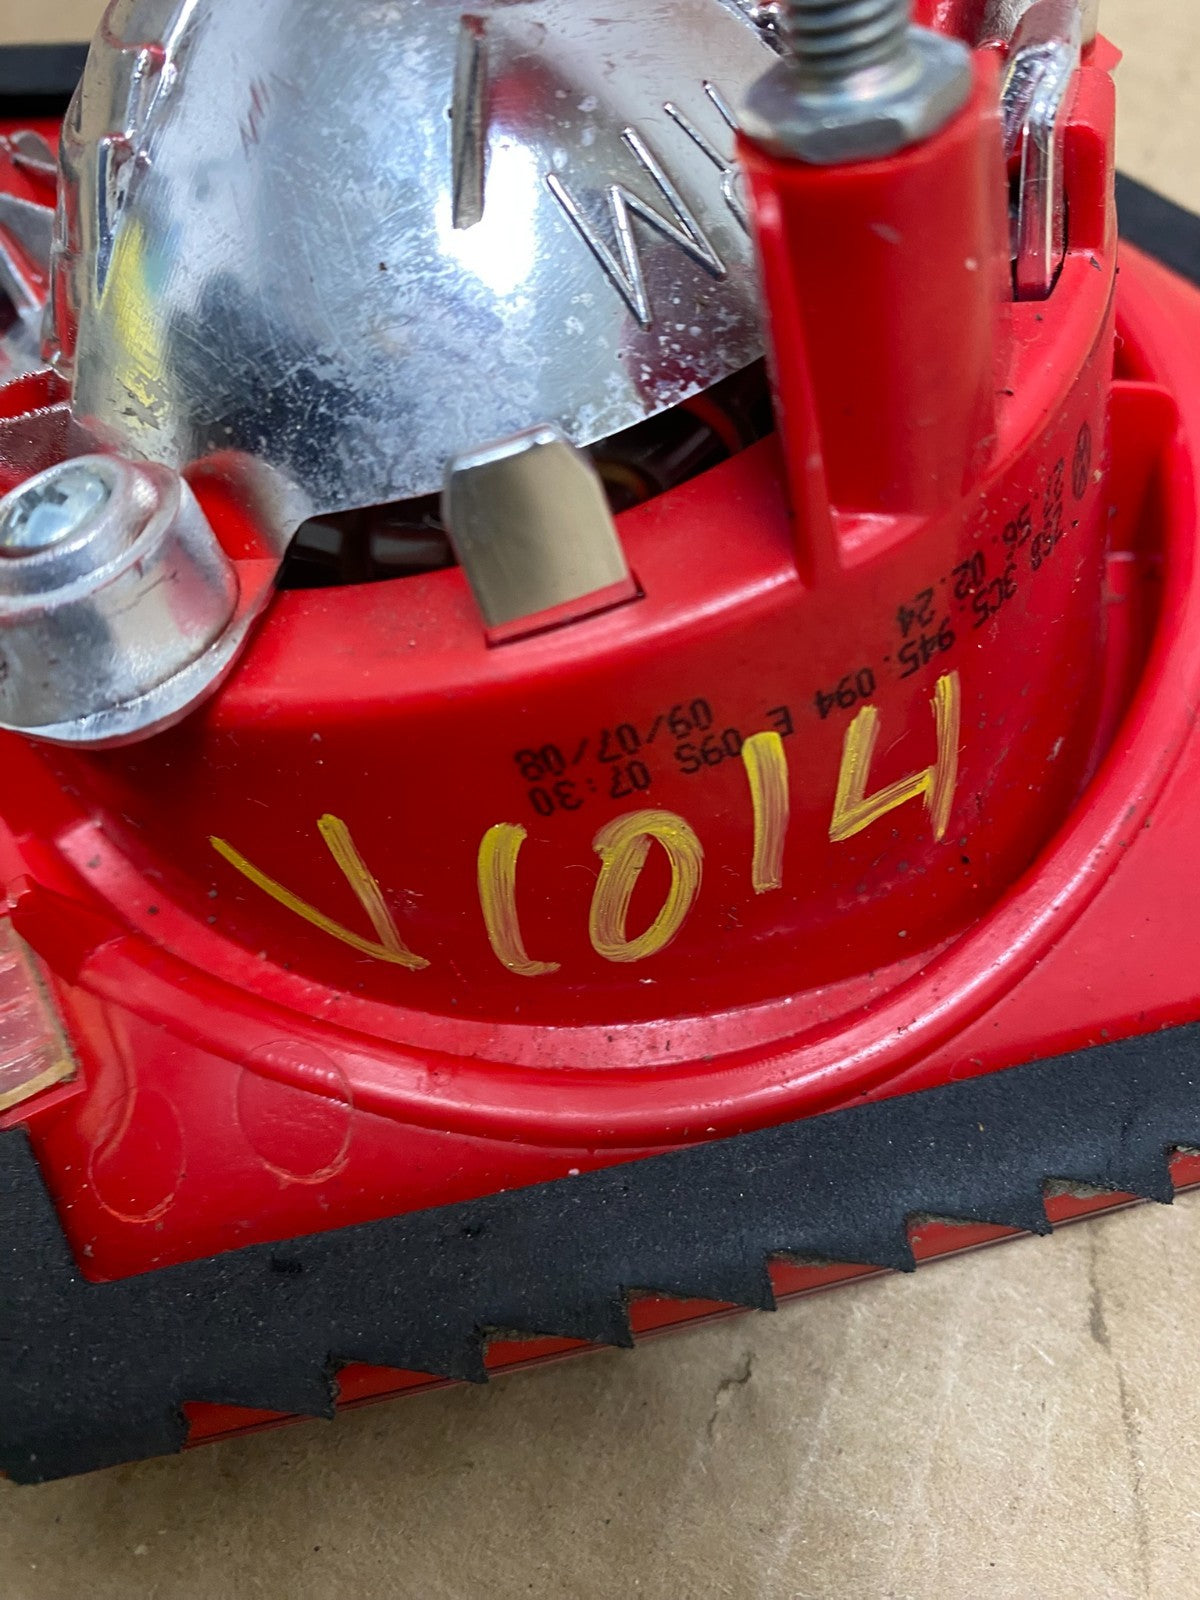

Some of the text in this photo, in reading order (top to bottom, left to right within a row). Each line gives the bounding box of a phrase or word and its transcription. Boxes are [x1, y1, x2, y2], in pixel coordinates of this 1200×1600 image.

[514, 697, 714, 782] 09/07/08
[765, 705, 795, 738] E
[528, 760, 652, 817] 07:30
